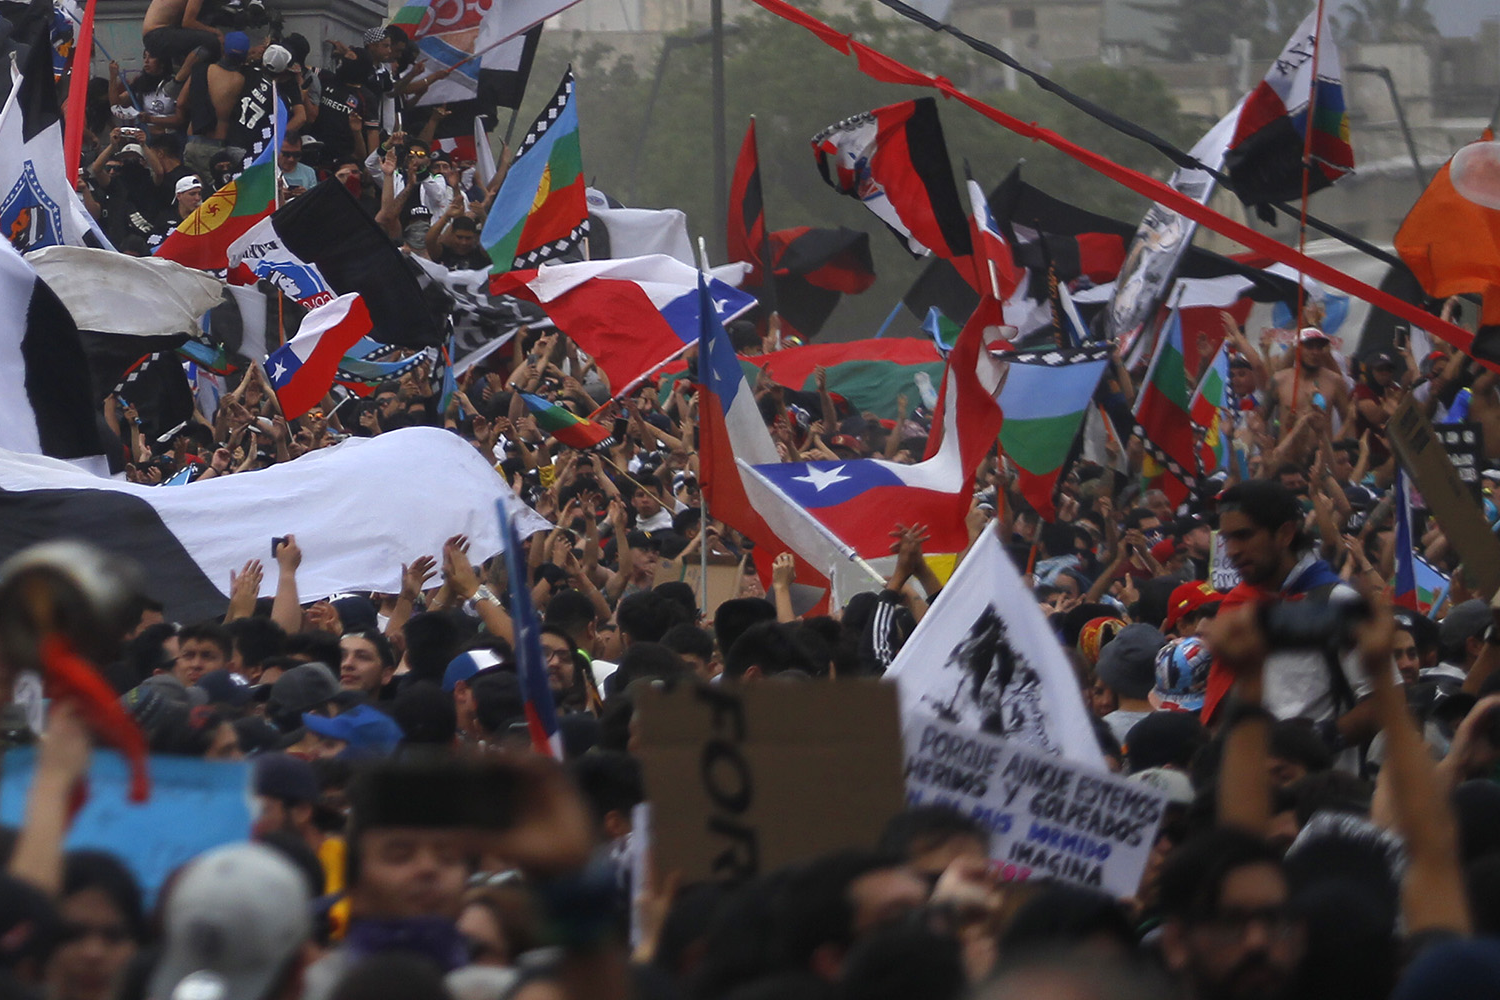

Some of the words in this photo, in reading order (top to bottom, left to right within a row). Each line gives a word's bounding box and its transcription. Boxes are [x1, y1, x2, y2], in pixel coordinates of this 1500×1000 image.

[239, 97, 265, 129] 17
[919, 725, 1002, 777] PORQUE
[1002, 753, 1075, 795] AUNQUE
[1075, 775, 1164, 823] ESTEMOS
[1028, 791, 1143, 847] GOLPEADOS
[1007, 841, 1104, 885] IMAGINA
